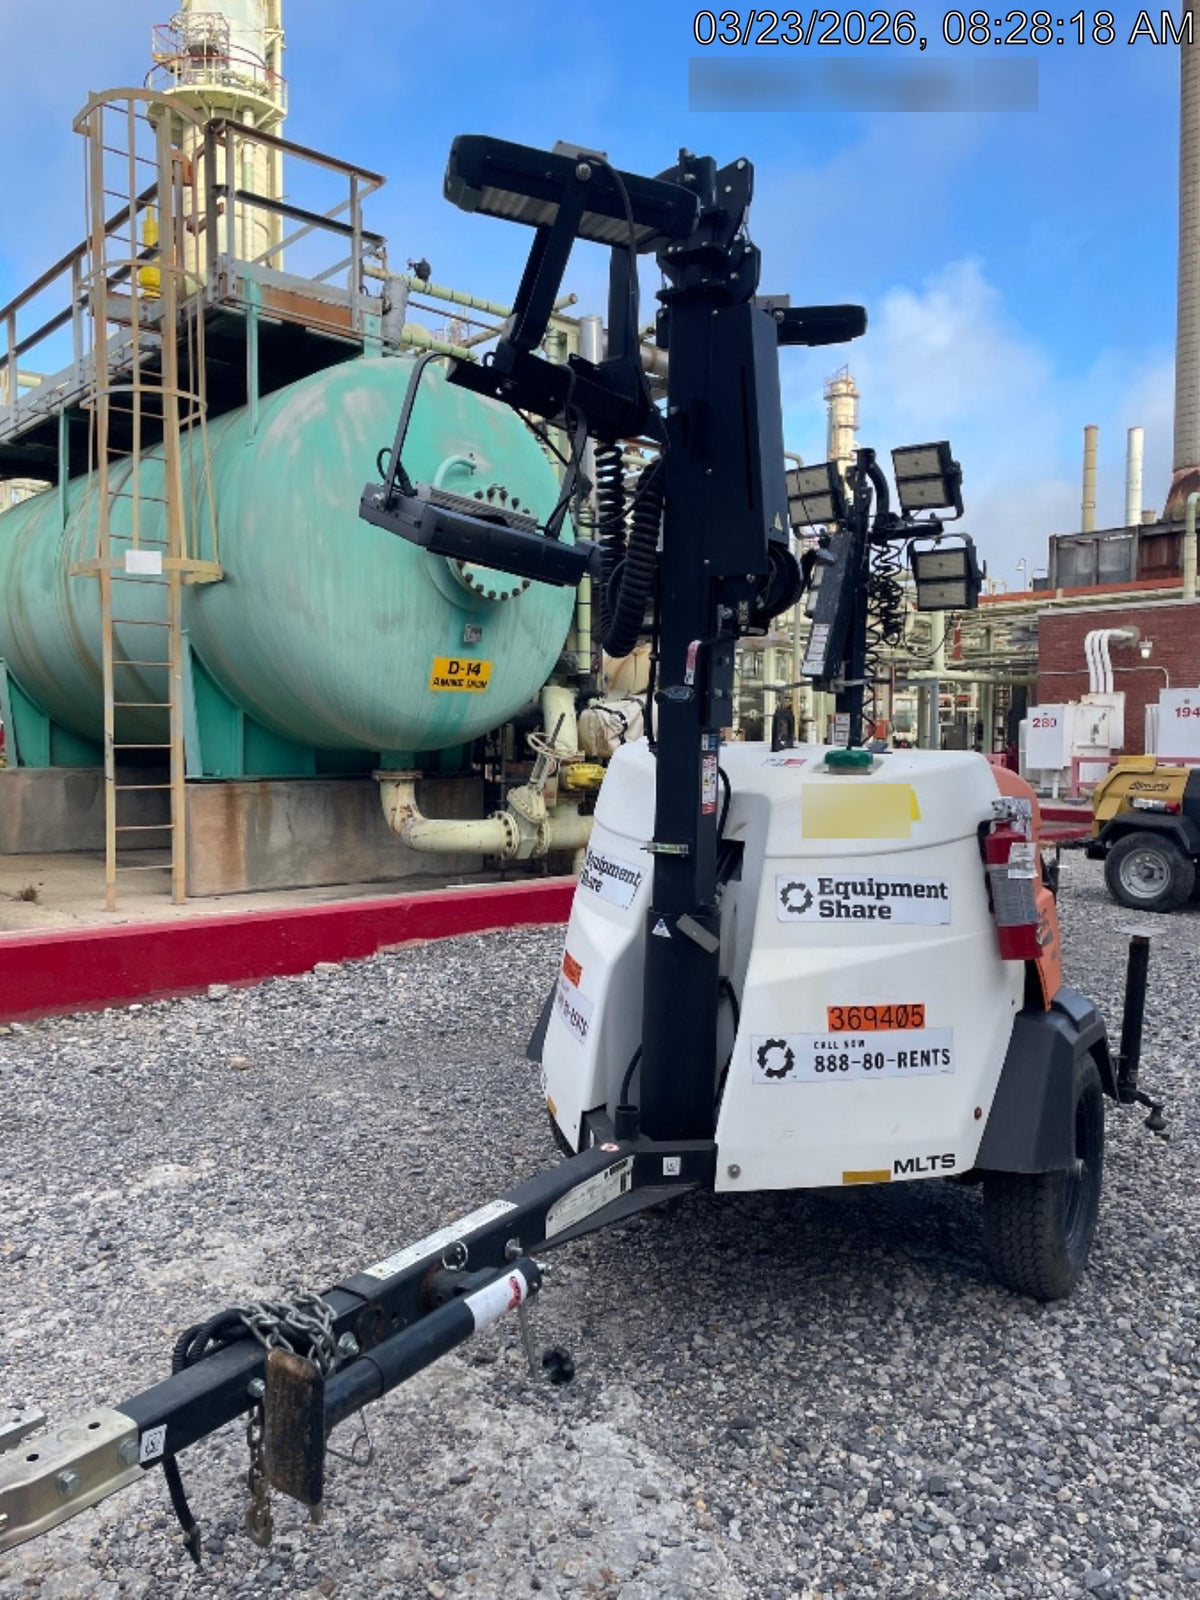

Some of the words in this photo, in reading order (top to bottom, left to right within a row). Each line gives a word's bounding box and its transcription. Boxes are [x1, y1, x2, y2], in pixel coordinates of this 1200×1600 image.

[448, 661, 481, 676] D-14
[1032, 717, 1057, 728] 280
[817, 878, 949, 900] Equipment
[819, 900, 892, 919] Share
[830, 1004, 925, 1031] 369405
[813, 1041, 839, 1050] CALL
[844, 1039, 866, 1049] NOW
[814, 1047, 951, 1074] 888-80-RENTS
[894, 1153, 956, 1175] MLTS
